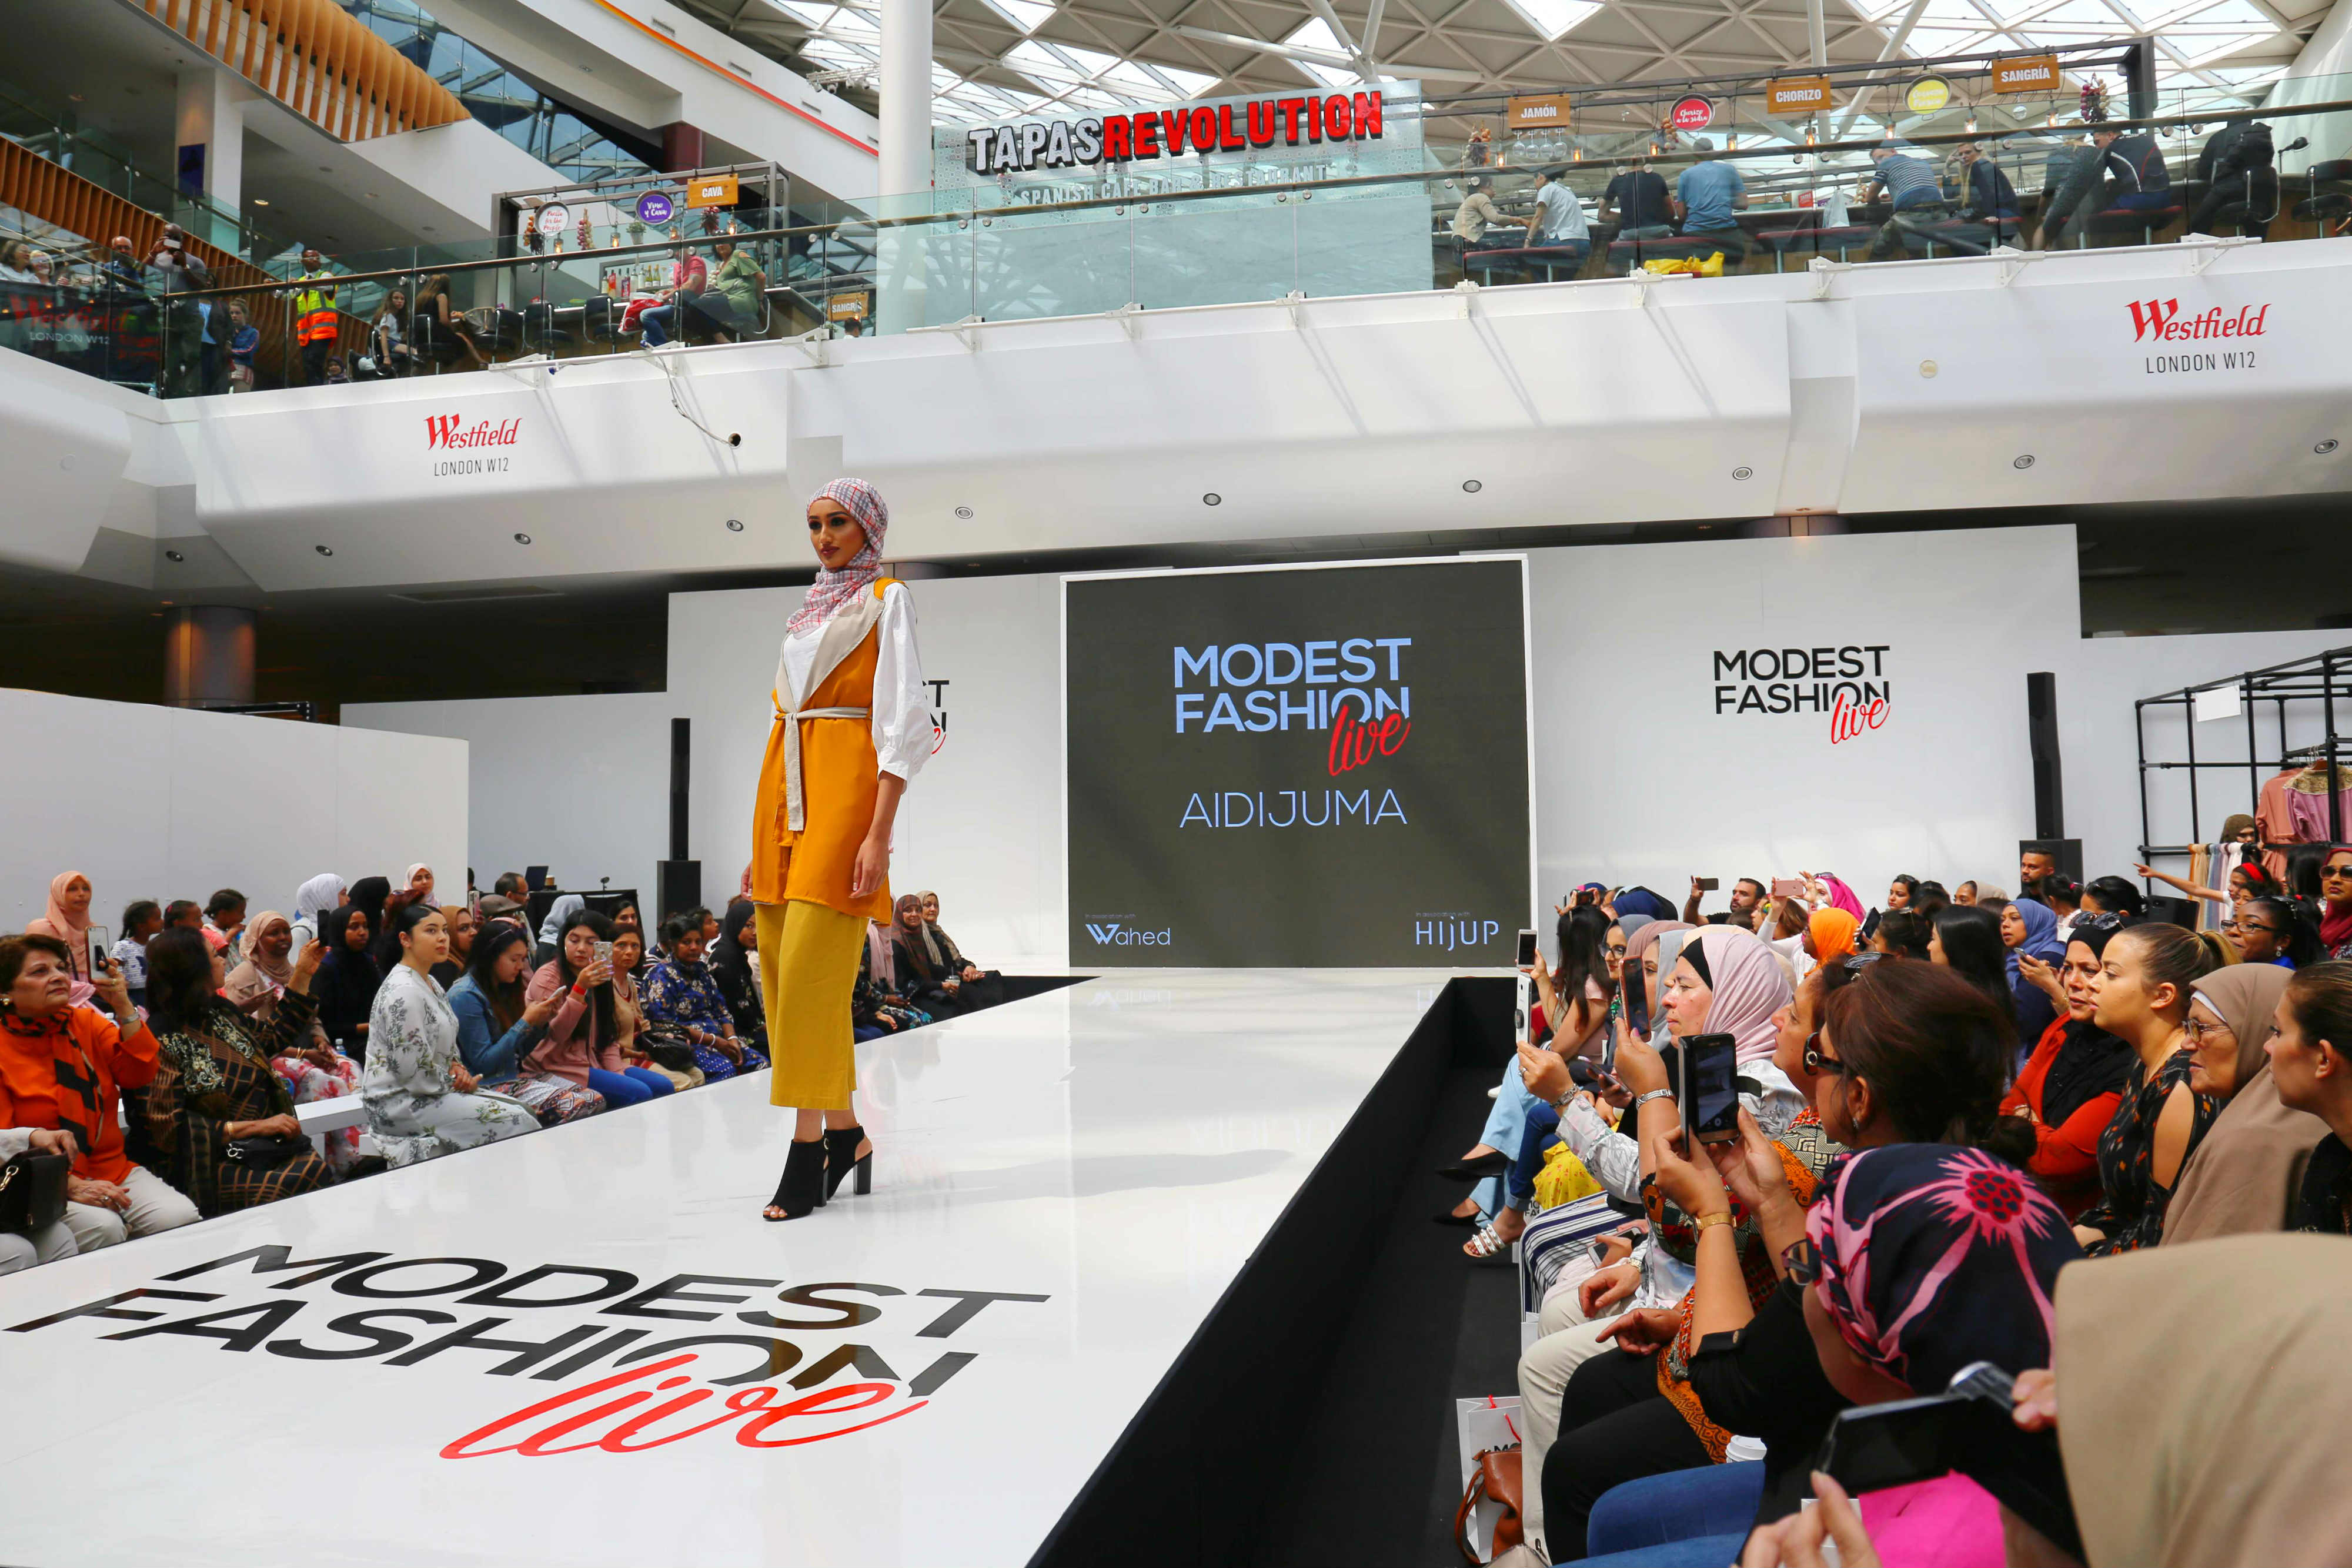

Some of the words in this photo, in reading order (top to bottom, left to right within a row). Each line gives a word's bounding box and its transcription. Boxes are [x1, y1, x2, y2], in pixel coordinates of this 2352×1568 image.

[2001, 65, 2050, 82] SANGRÍA
[1521, 103, 1557, 118] JAMÓN
[1776, 89, 1822, 102] CHORIZO
[701, 186, 723, 198] CAVA
[1021, 184, 1094, 205] SPANISH
[1189, 176, 1204, 190] &
[1211, 165, 1327, 189] RESTAURANT
[2124, 297, 2272, 342] Westfield
[30, 332, 83, 343] LONDON
[88, 336, 110, 345] W12
[2146, 353, 2216, 373] LONDON
[2223, 351, 2256, 369] W12
[423, 413, 523, 450] Westfield
[435, 459, 482, 476] LONDON
[487, 457, 509, 472] W12
[1174, 638, 1411, 688] MODEST
[1714, 646, 1890, 681] MODEST
[1176, 687, 1409, 733] FASHION
[1715, 681, 1889, 714] FASHION
[1831, 693, 1890, 744] live
[1328, 704, 1411, 776] live
[1180, 789, 1407, 828] AIDIJUMA
[1085, 924, 1170, 945] Wahed
[153, 1244, 1051, 1338] MODEST
[2, 1288, 980, 1398] FASHION
[439, 1353, 929, 1459] live
